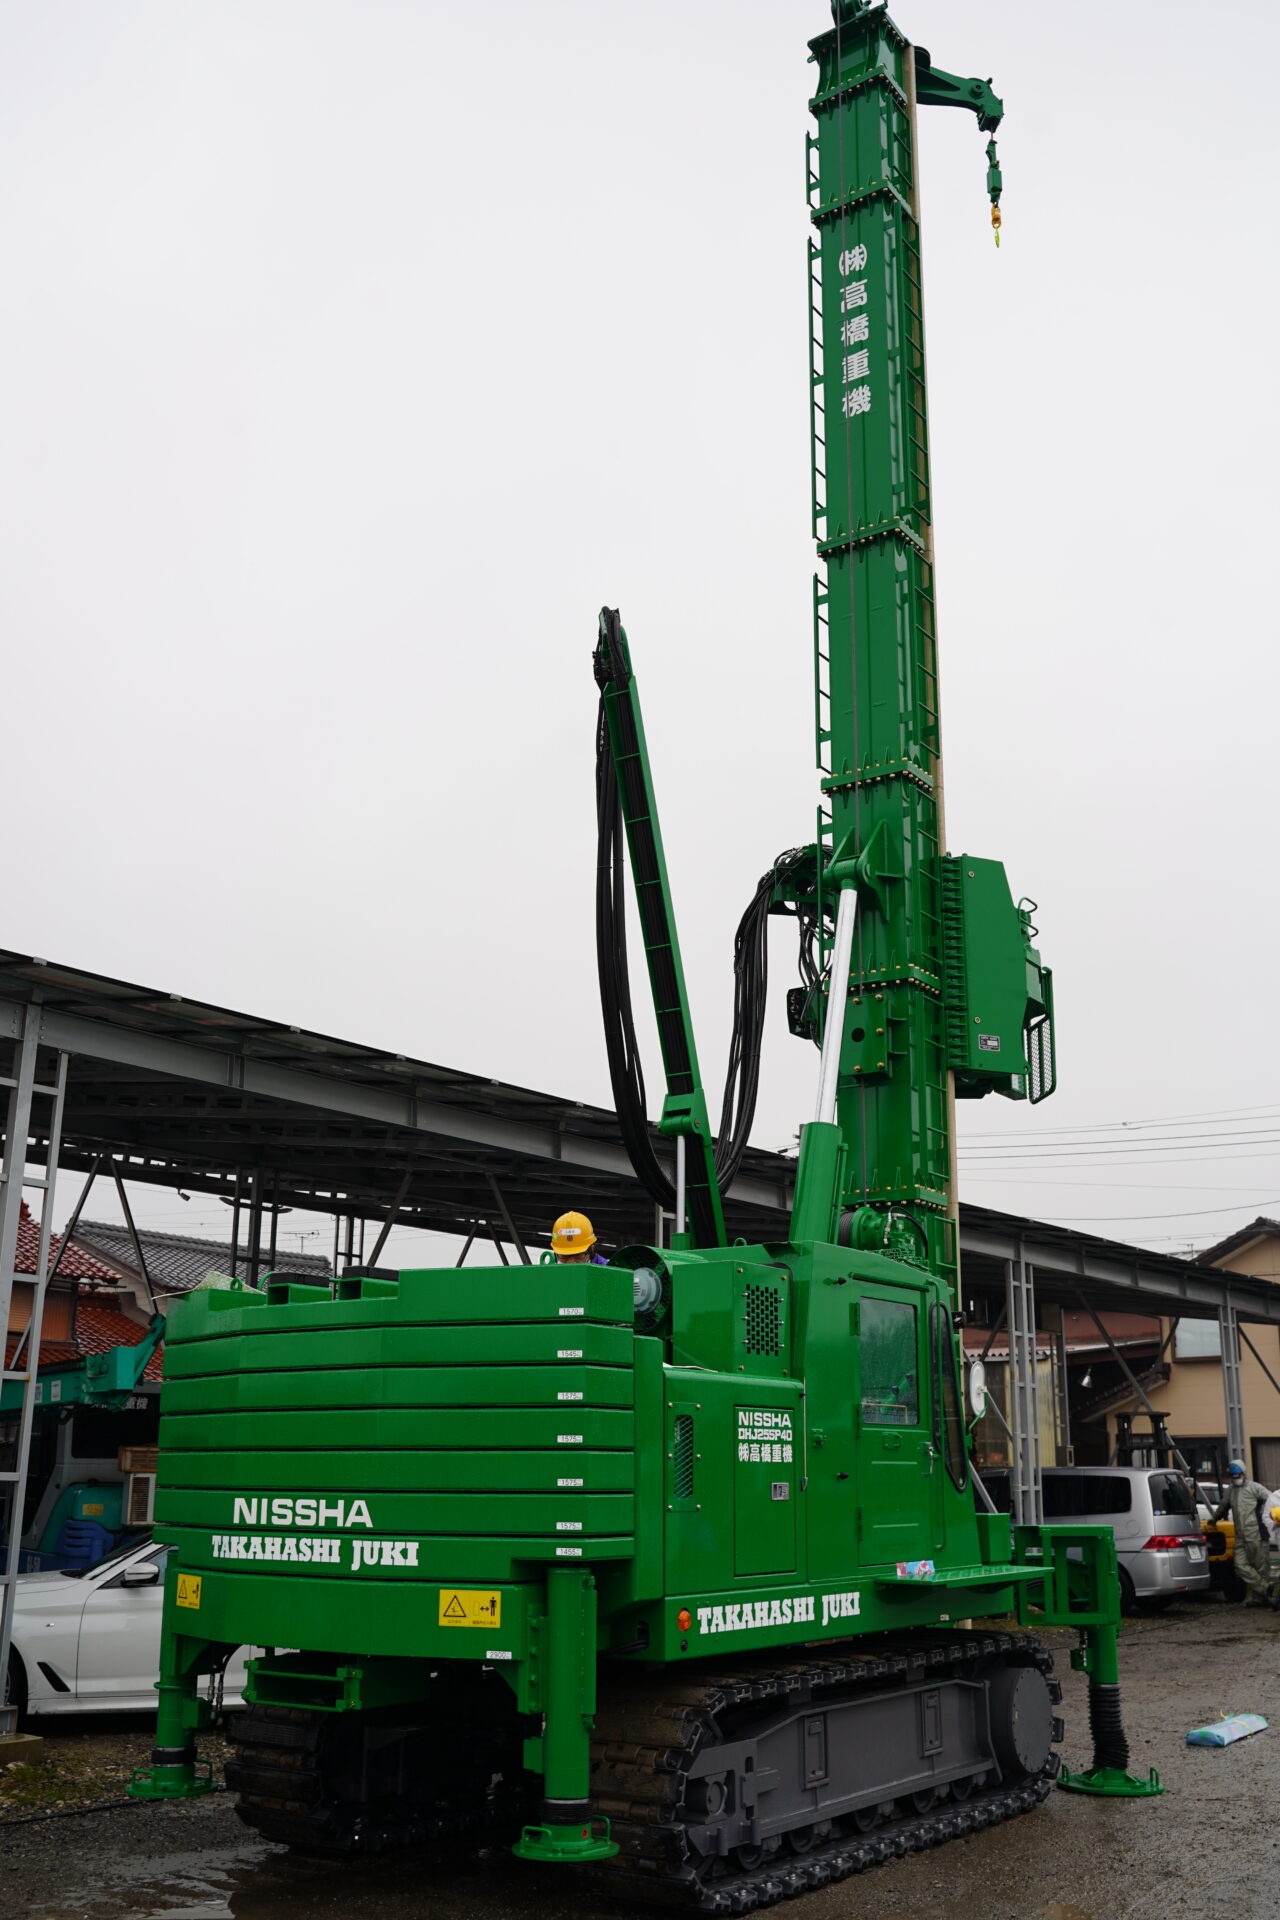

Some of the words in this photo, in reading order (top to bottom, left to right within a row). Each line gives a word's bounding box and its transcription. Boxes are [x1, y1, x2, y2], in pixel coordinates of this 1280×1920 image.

[738, 1411, 791, 1427] NISSHA
[233, 1497, 373, 1527] NISSHA
[212, 1535, 340, 1563] TAKAHASHI
[351, 1540, 419, 1570] JUKI
[698, 1597, 815, 1634] TAKAHASHI
[821, 1591, 860, 1626] JUKI
